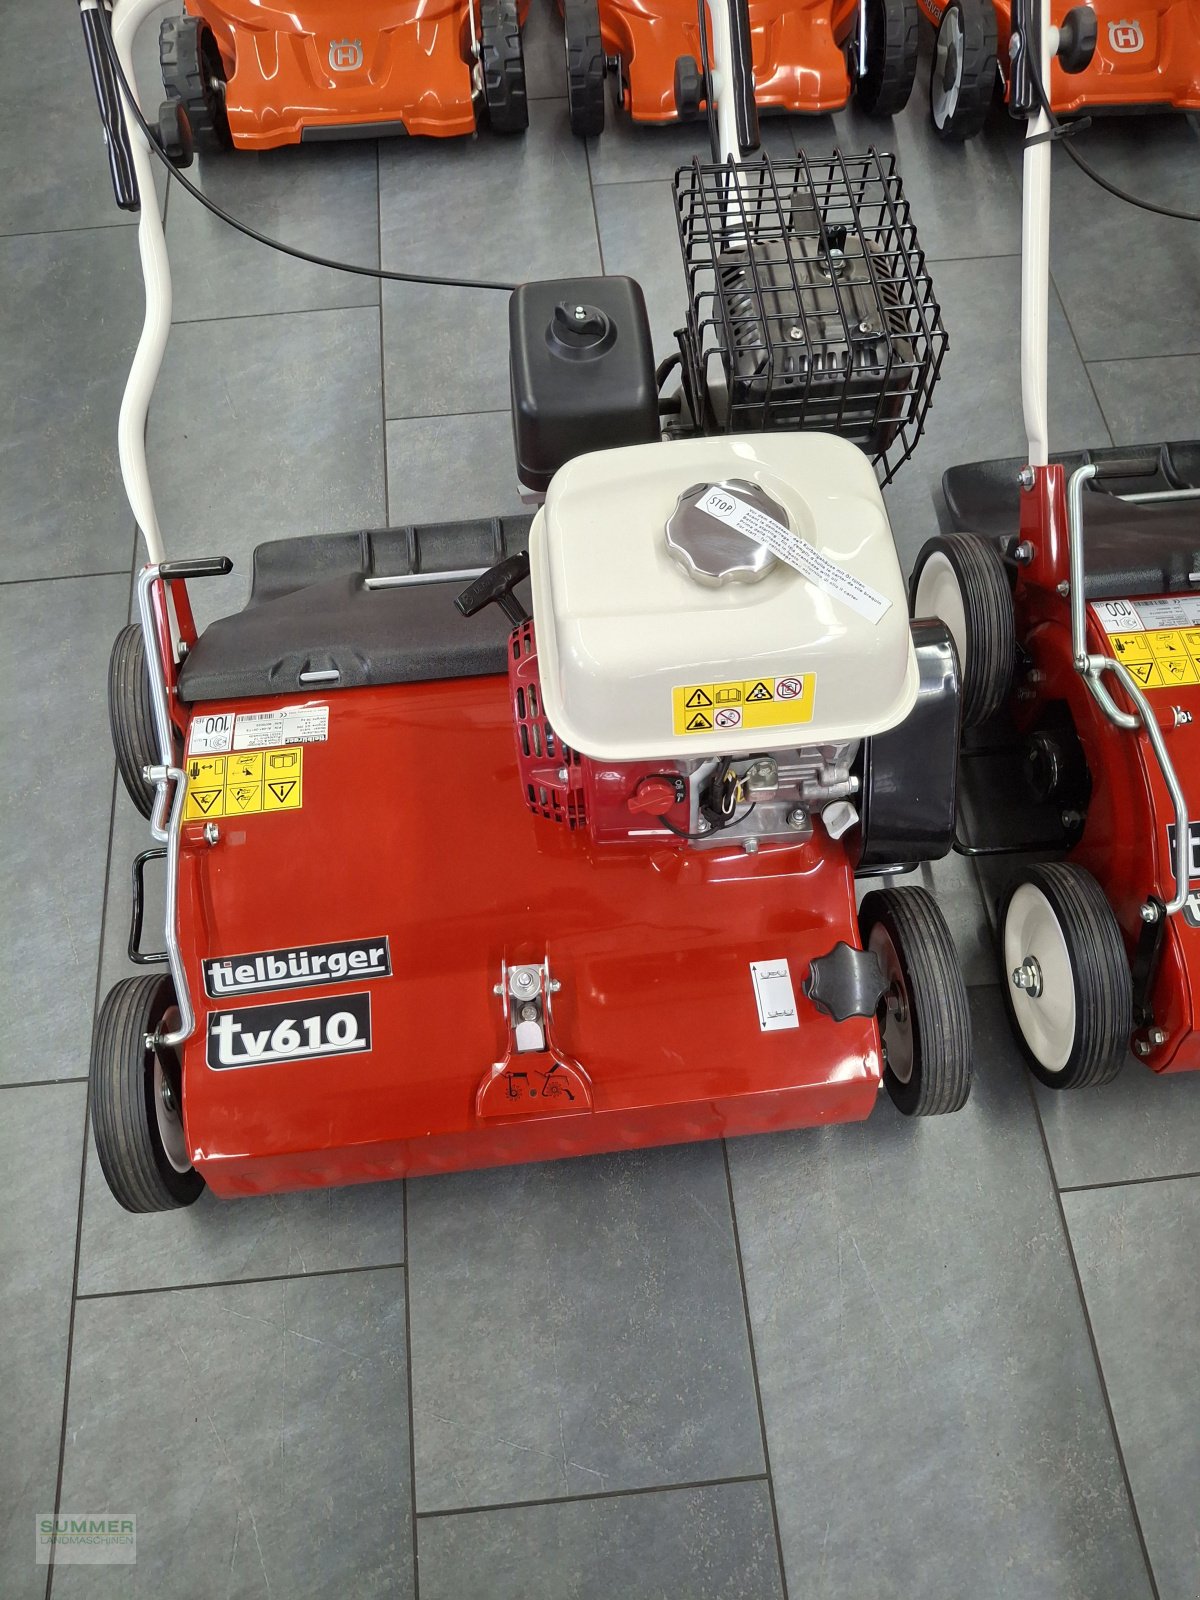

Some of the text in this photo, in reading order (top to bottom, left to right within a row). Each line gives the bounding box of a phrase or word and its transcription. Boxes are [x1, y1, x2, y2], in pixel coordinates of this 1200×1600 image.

[708, 496, 733, 513] STOP
[1105, 601, 1131, 617] 100
[205, 716, 229, 735] 100
[208, 946, 386, 994] tielbürger
[211, 1012, 367, 1065] tv610
